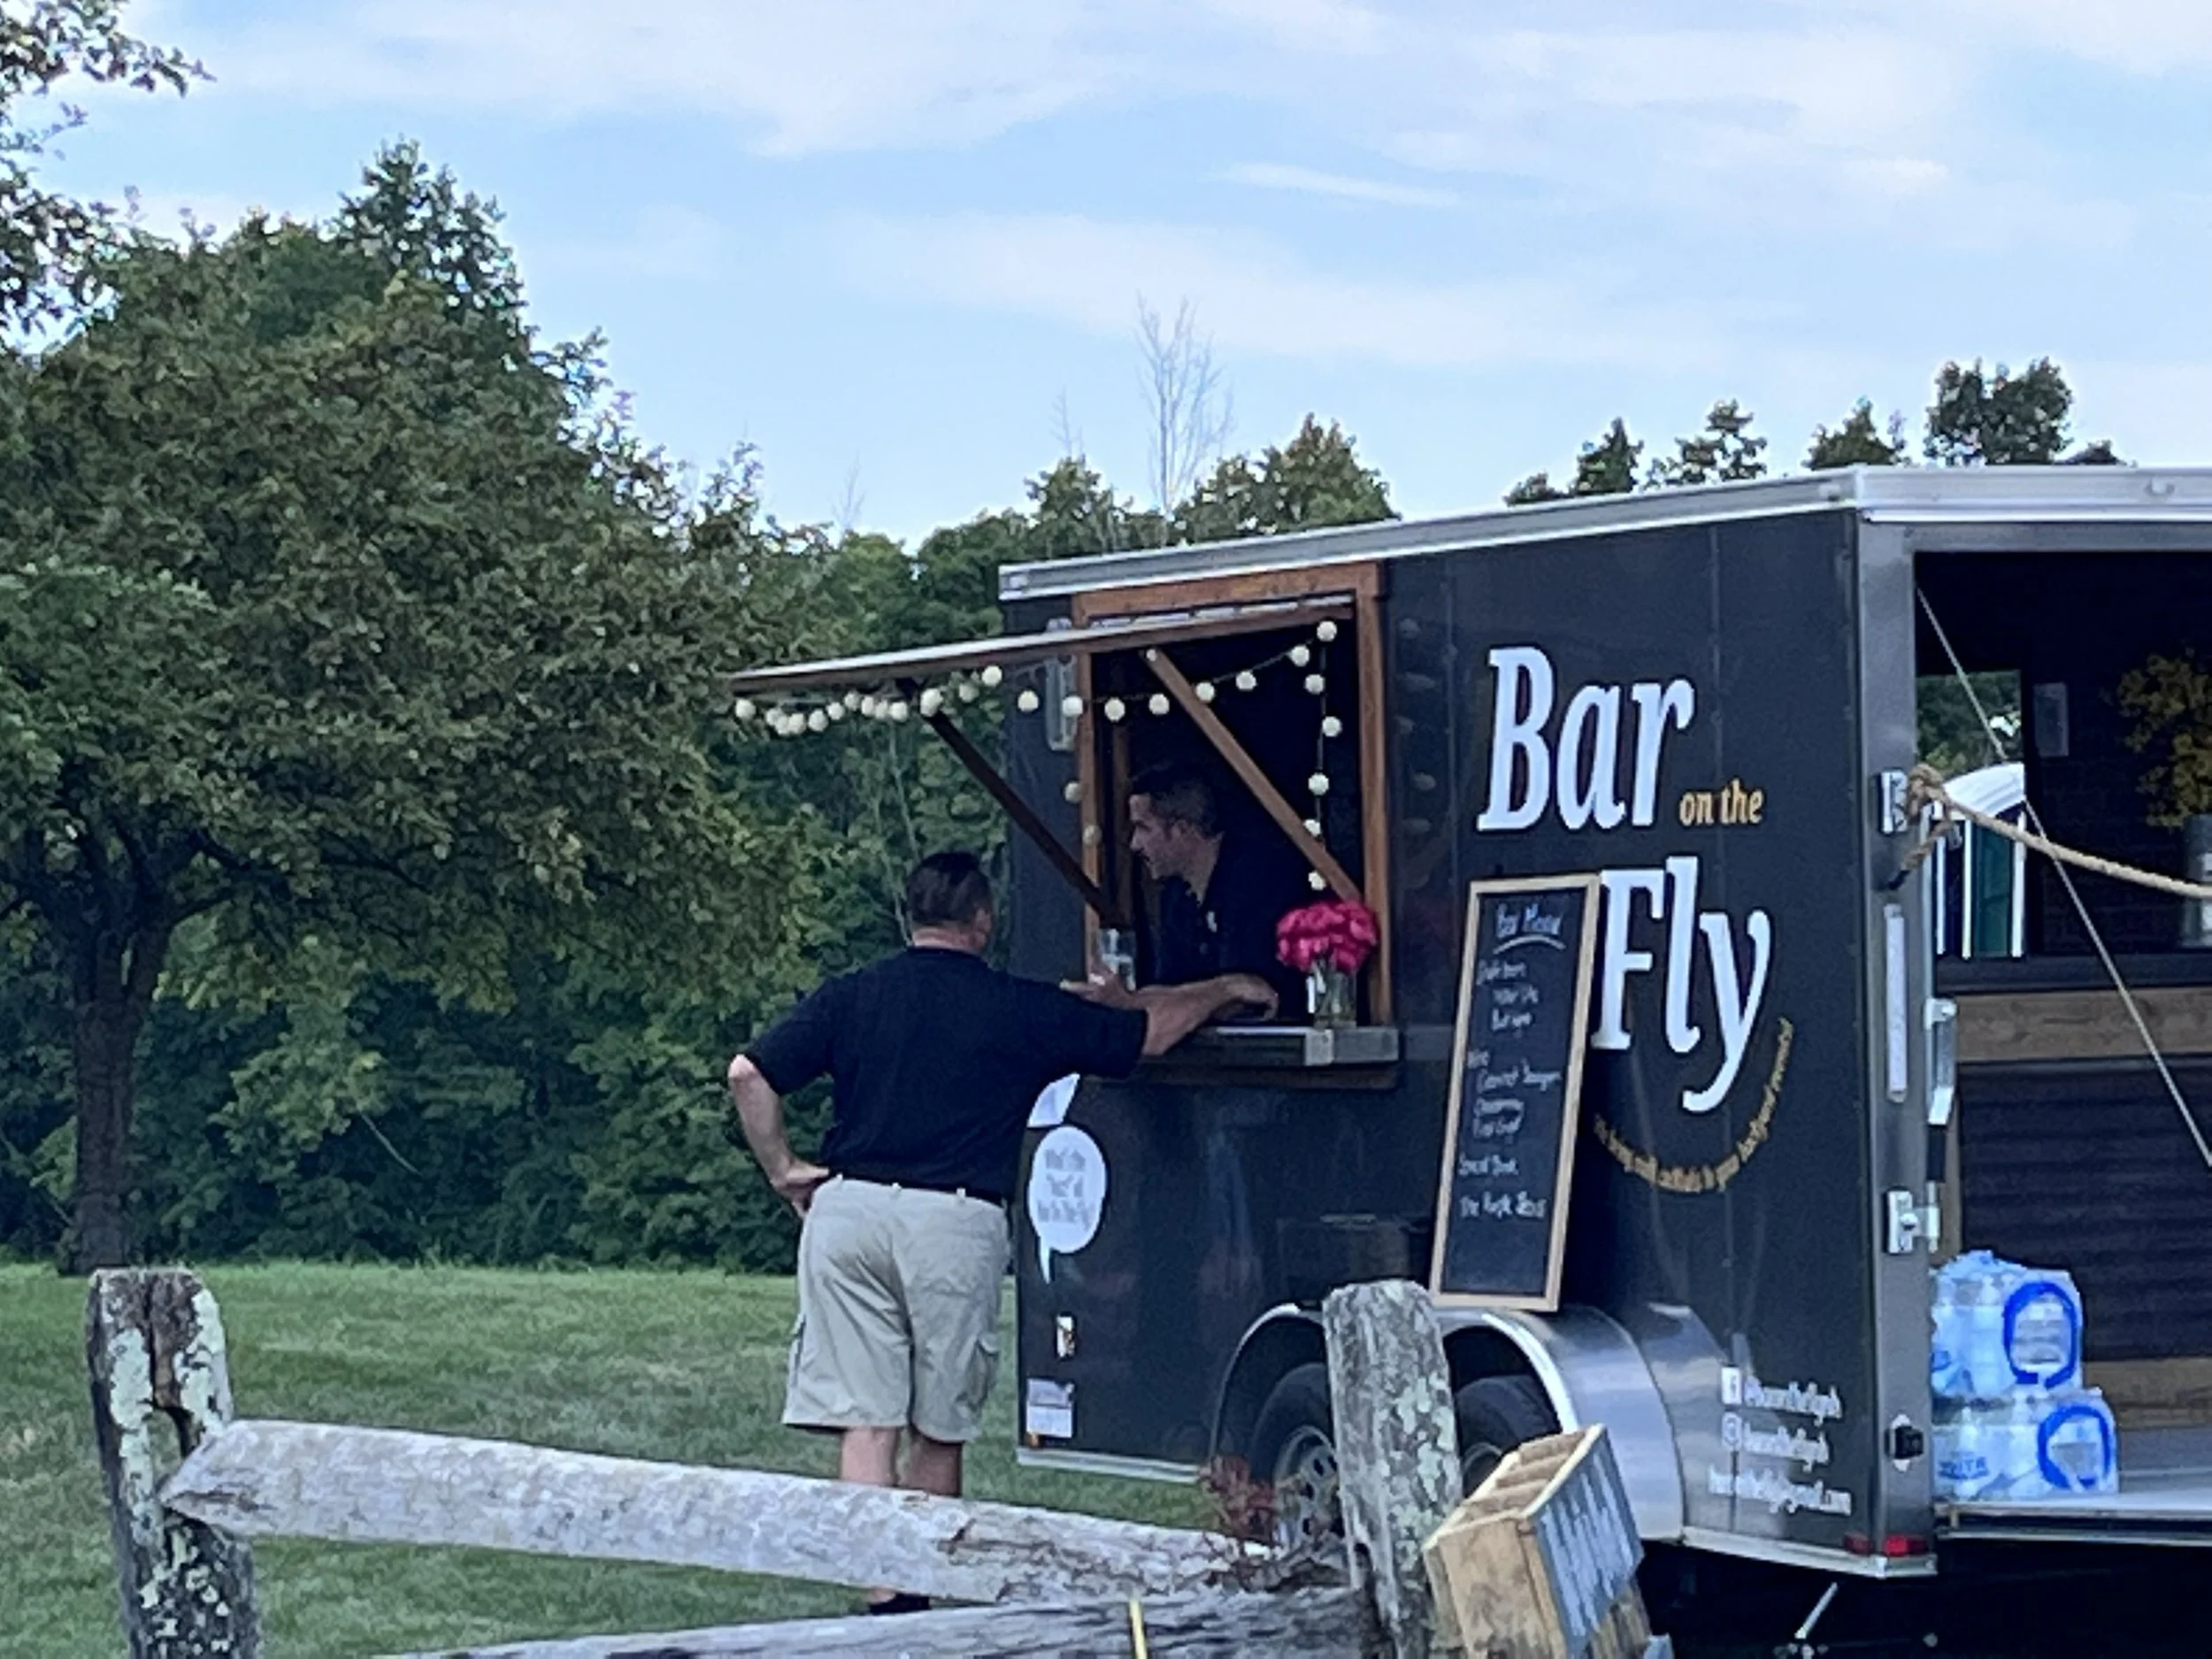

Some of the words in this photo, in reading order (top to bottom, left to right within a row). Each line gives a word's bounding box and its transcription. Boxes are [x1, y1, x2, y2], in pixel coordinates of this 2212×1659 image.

[1477, 646, 1695, 831] Bar
[1679, 790, 1714, 826] on
[1719, 780, 1763, 825] the
[1591, 856, 1770, 1112] Fly
